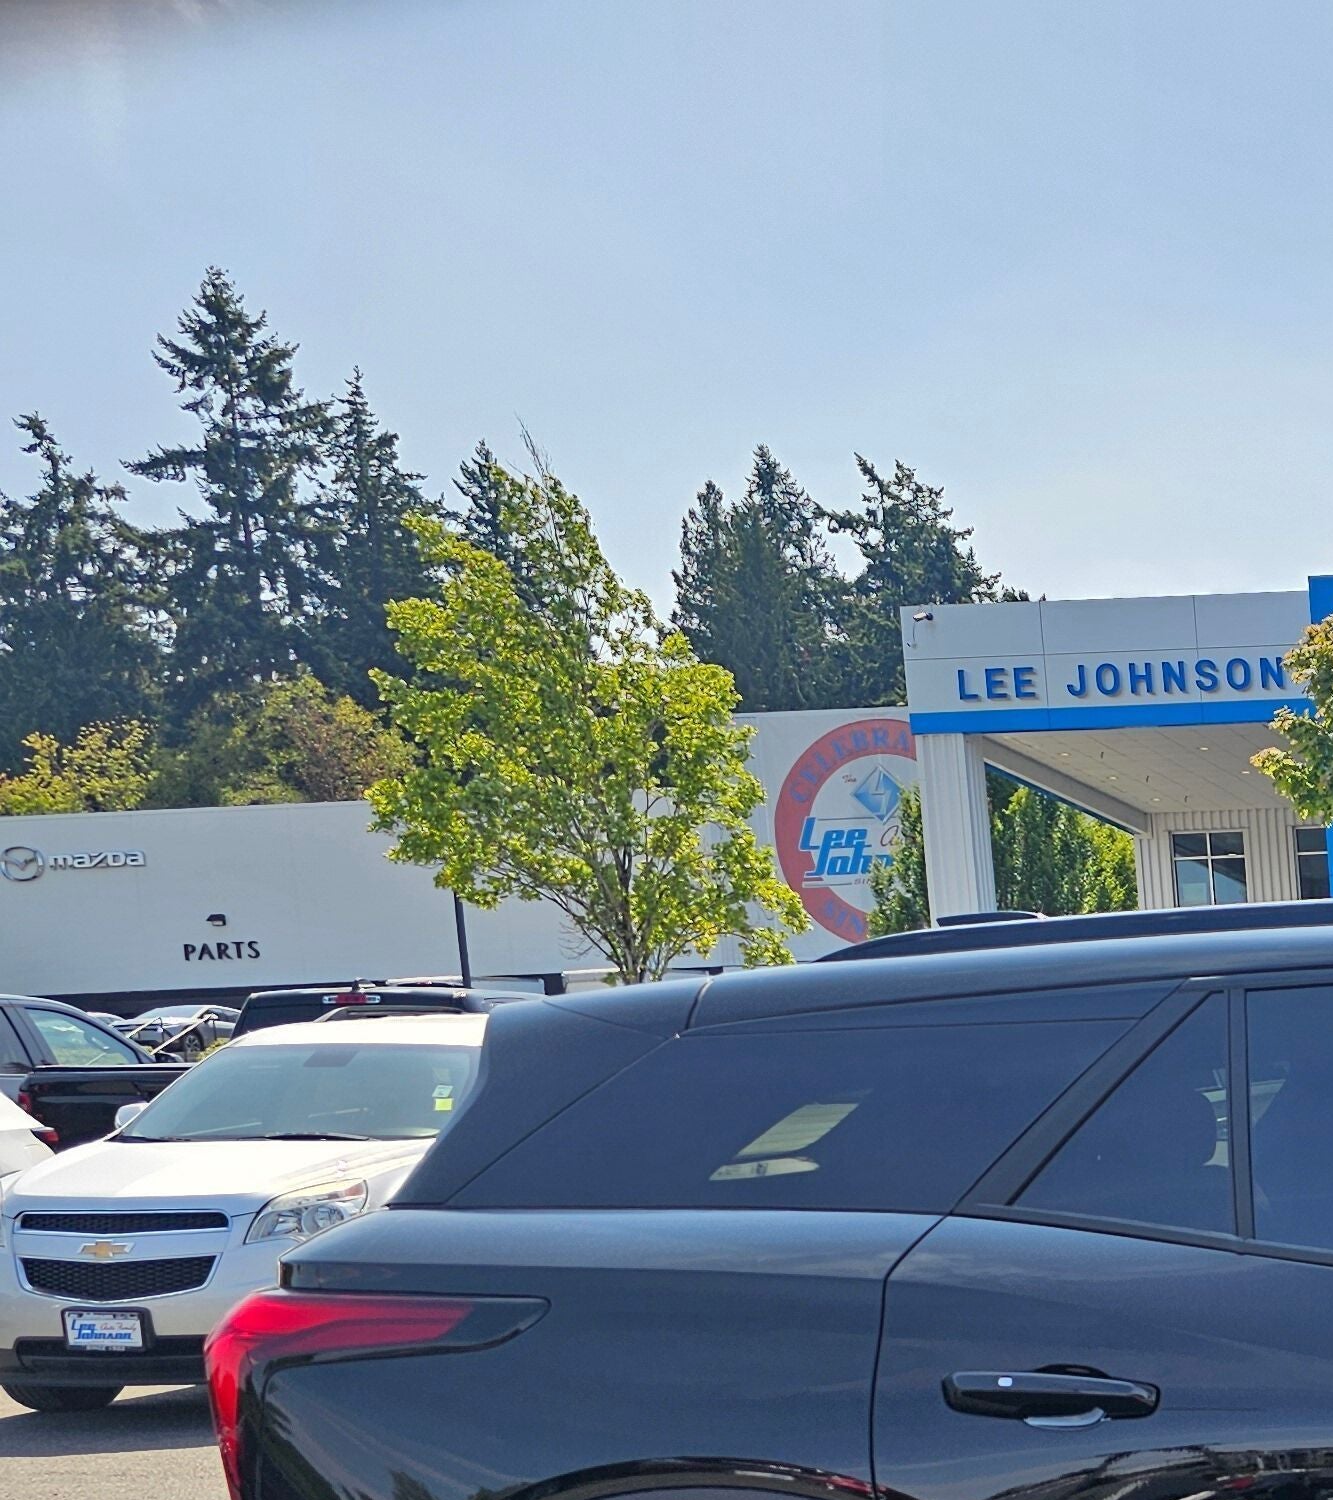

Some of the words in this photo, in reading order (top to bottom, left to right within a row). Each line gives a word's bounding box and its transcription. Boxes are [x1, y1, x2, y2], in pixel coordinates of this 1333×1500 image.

[957, 666, 1037, 700] LEE
[1066, 656, 1286, 697] JOHNSON
[799, 816, 872, 850] Lee
[49, 851, 146, 869] mazda
[183, 940, 260, 961] PARTS
